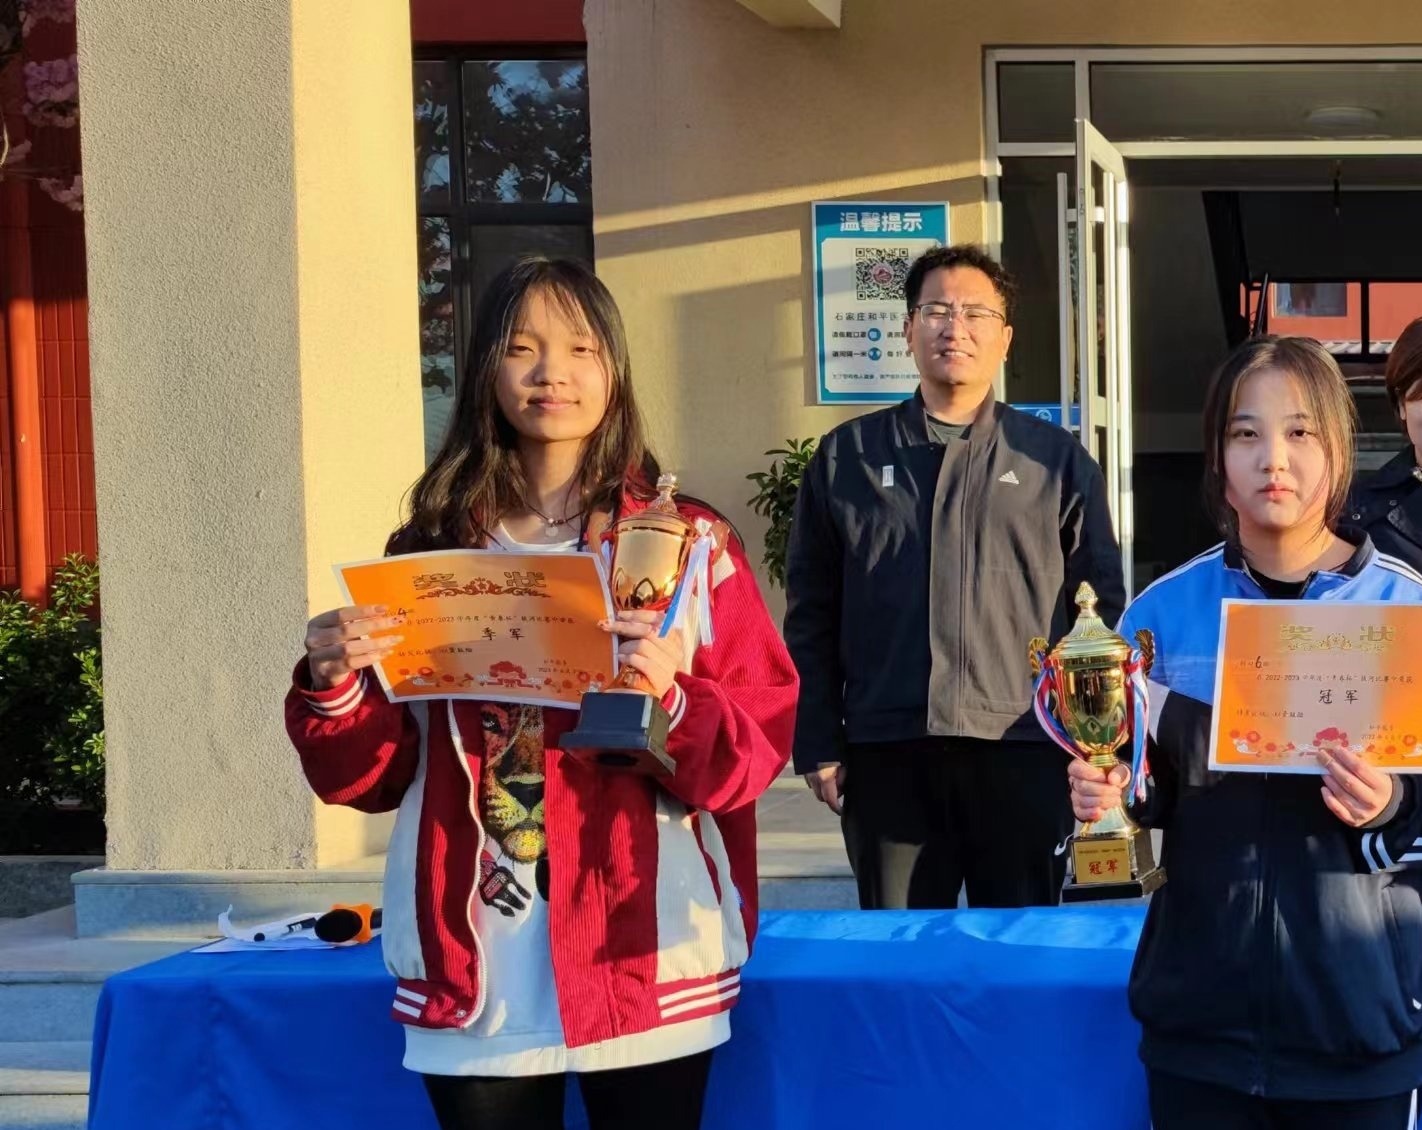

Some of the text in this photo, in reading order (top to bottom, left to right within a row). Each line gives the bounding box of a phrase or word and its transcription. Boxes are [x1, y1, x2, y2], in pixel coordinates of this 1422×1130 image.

[839, 211, 923, 232] 温馨提示
[481, 626, 525, 640] 季军
[1279, 624, 1396, 643] 奖状
[1318, 688, 1359, 704] 冠军
